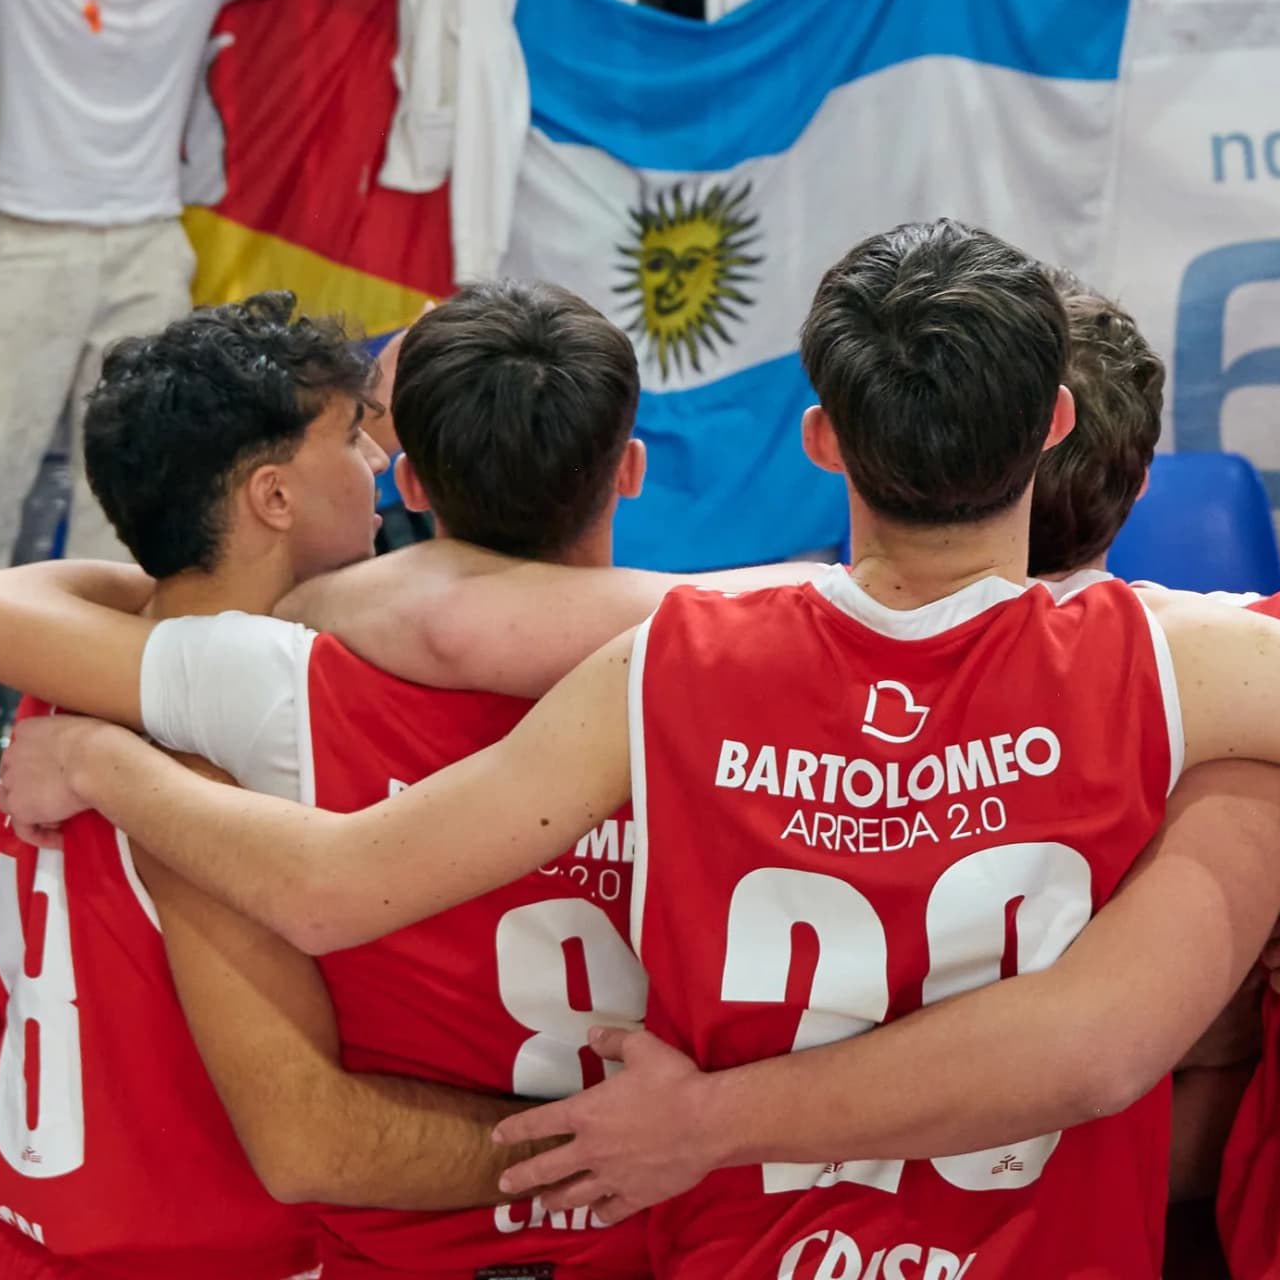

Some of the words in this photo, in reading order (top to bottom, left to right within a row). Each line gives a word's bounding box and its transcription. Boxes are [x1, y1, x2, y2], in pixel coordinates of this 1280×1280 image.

[714, 726, 1061, 810] BARTOLOMEO
[780, 807, 941, 853] ARREDA
[946, 797, 1007, 840] 2.0
